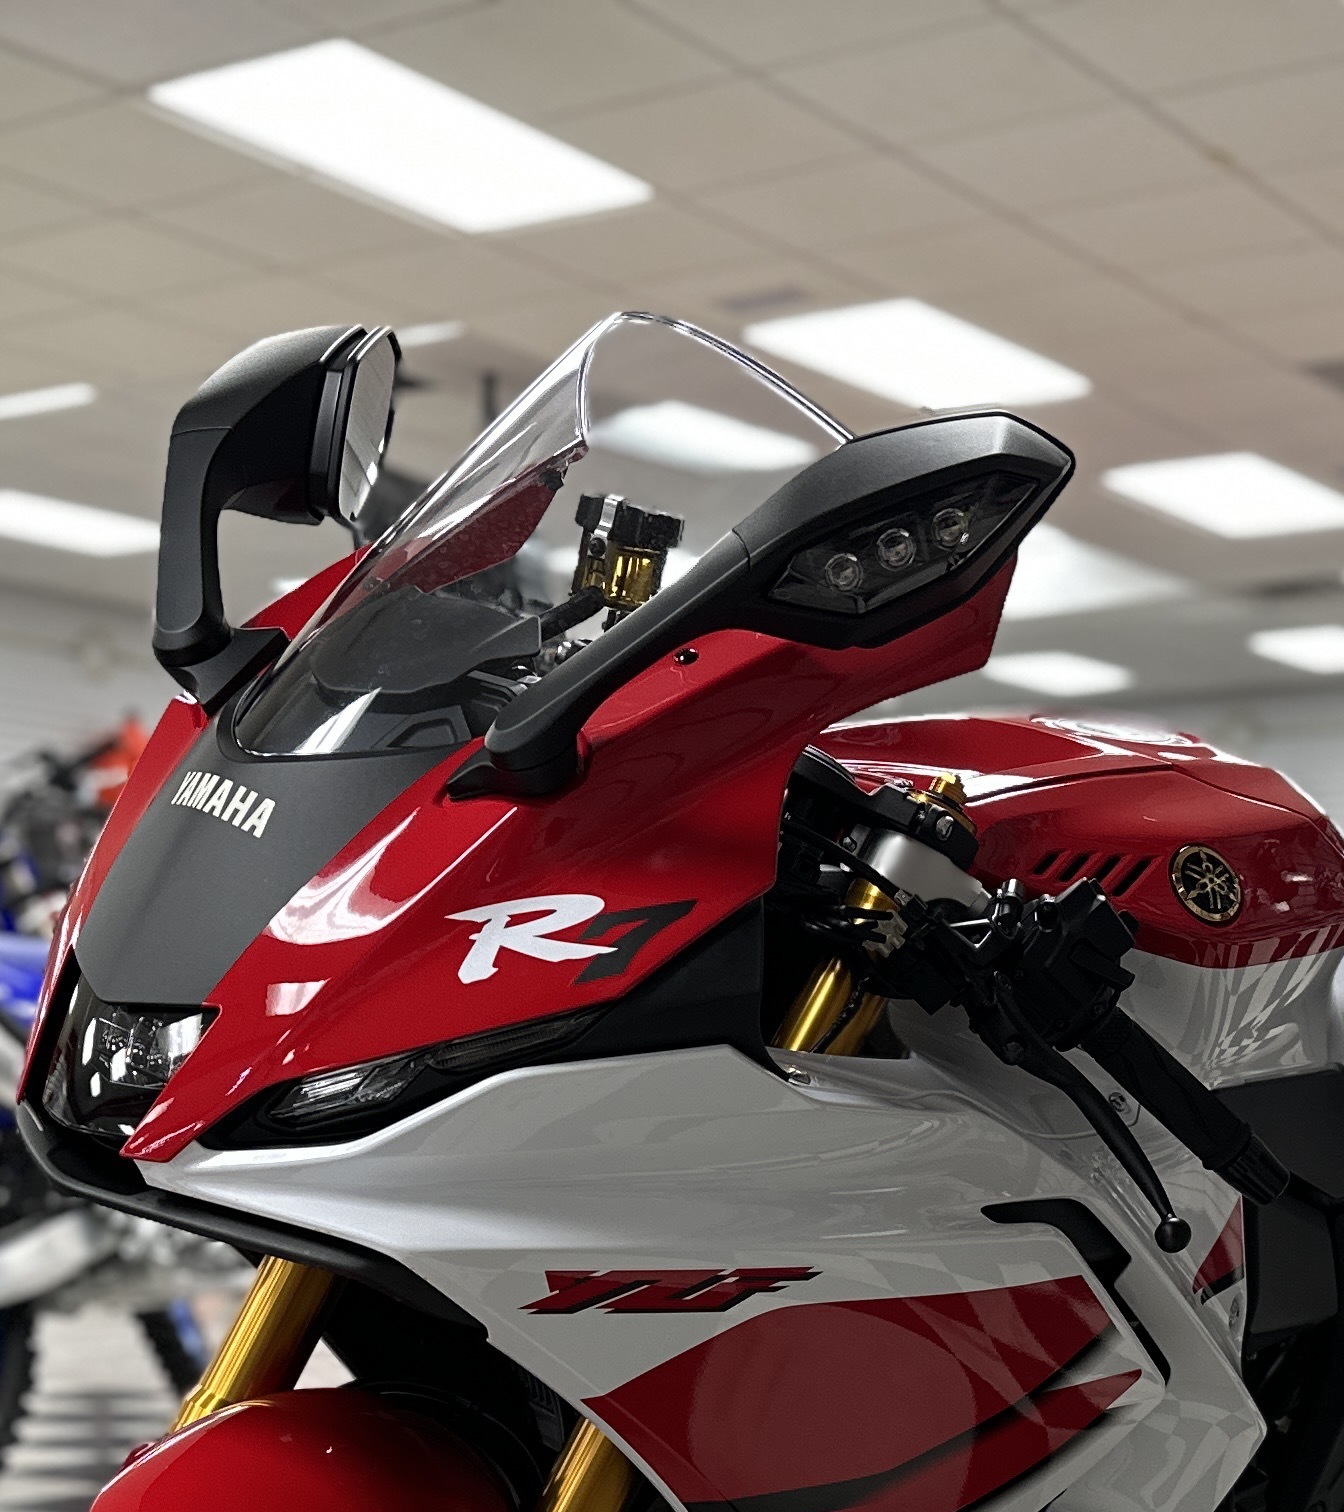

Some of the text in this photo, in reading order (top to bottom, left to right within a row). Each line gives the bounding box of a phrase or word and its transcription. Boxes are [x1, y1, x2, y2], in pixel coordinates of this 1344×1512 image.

[170, 771, 276, 839] YAMAHA
[444, 893, 699, 987] R7
[517, 1265, 824, 1315] YZF
